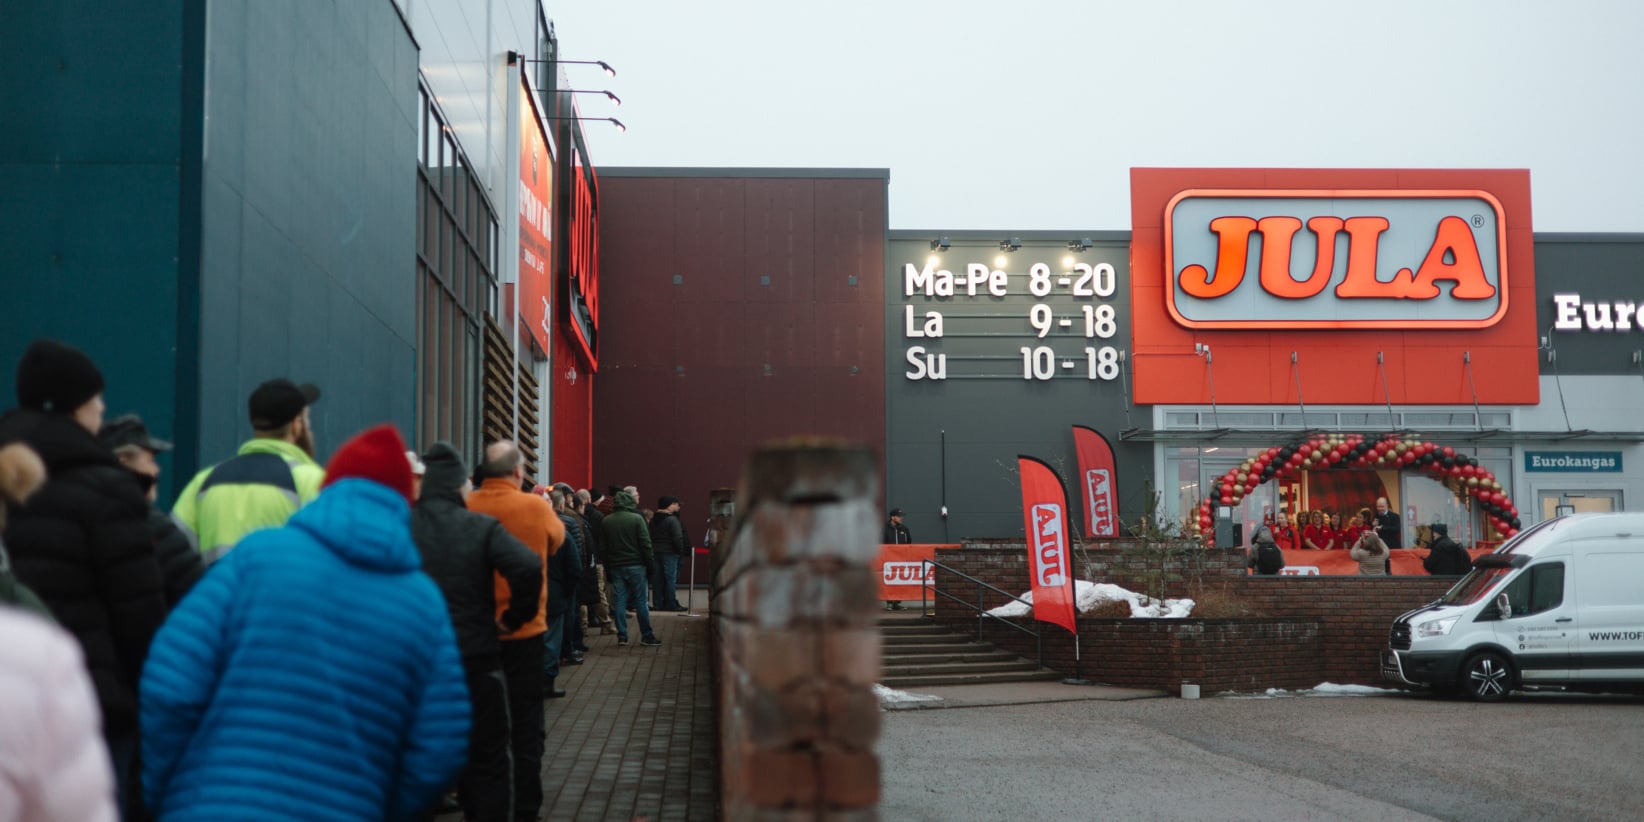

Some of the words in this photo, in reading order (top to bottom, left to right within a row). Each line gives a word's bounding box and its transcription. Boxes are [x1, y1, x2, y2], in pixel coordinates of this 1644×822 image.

[1178, 215, 1496, 300] JULA
[905, 262, 1008, 297] Ma-Pe
[1029, 262, 1051, 297] 8
[905, 304, 944, 338] La
[1030, 303, 1053, 338] 9
[1082, 304, 1117, 338] 18
[905, 346, 947, 380] Su
[1020, 346, 1055, 380] 10
[1085, 346, 1119, 380] 18
[1532, 455, 1615, 469] Eurokangas
[1589, 631, 1644, 641] WWW.TOF
